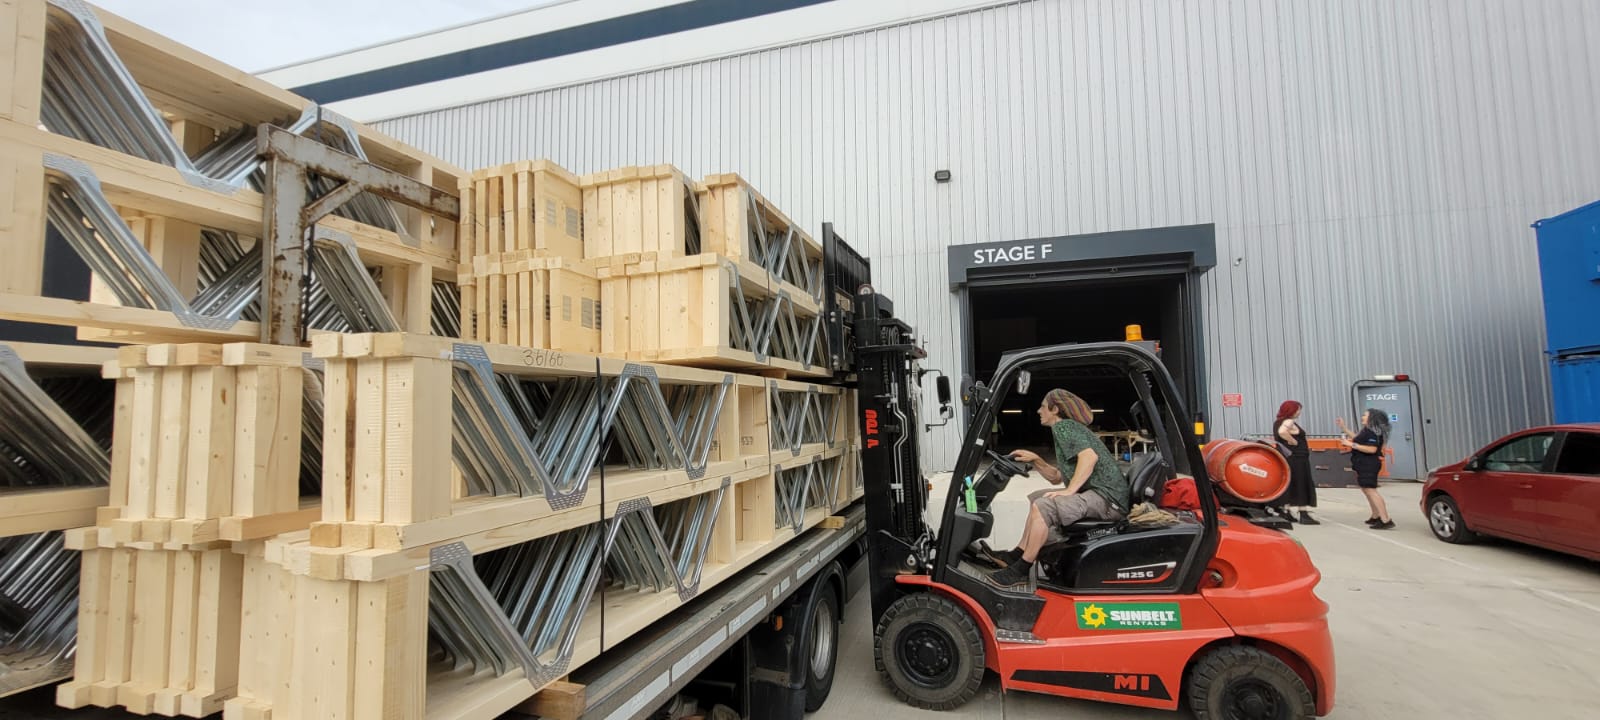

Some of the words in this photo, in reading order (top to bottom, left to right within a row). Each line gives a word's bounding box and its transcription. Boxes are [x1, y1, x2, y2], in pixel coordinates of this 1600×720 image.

[974, 245, 1035, 264] STAGE
[1041, 243, 1053, 259] F
[1366, 393, 1398, 401] STAGE
[1110, 610, 1175, 622] SUNBELT
[1114, 675, 1150, 691] MI
